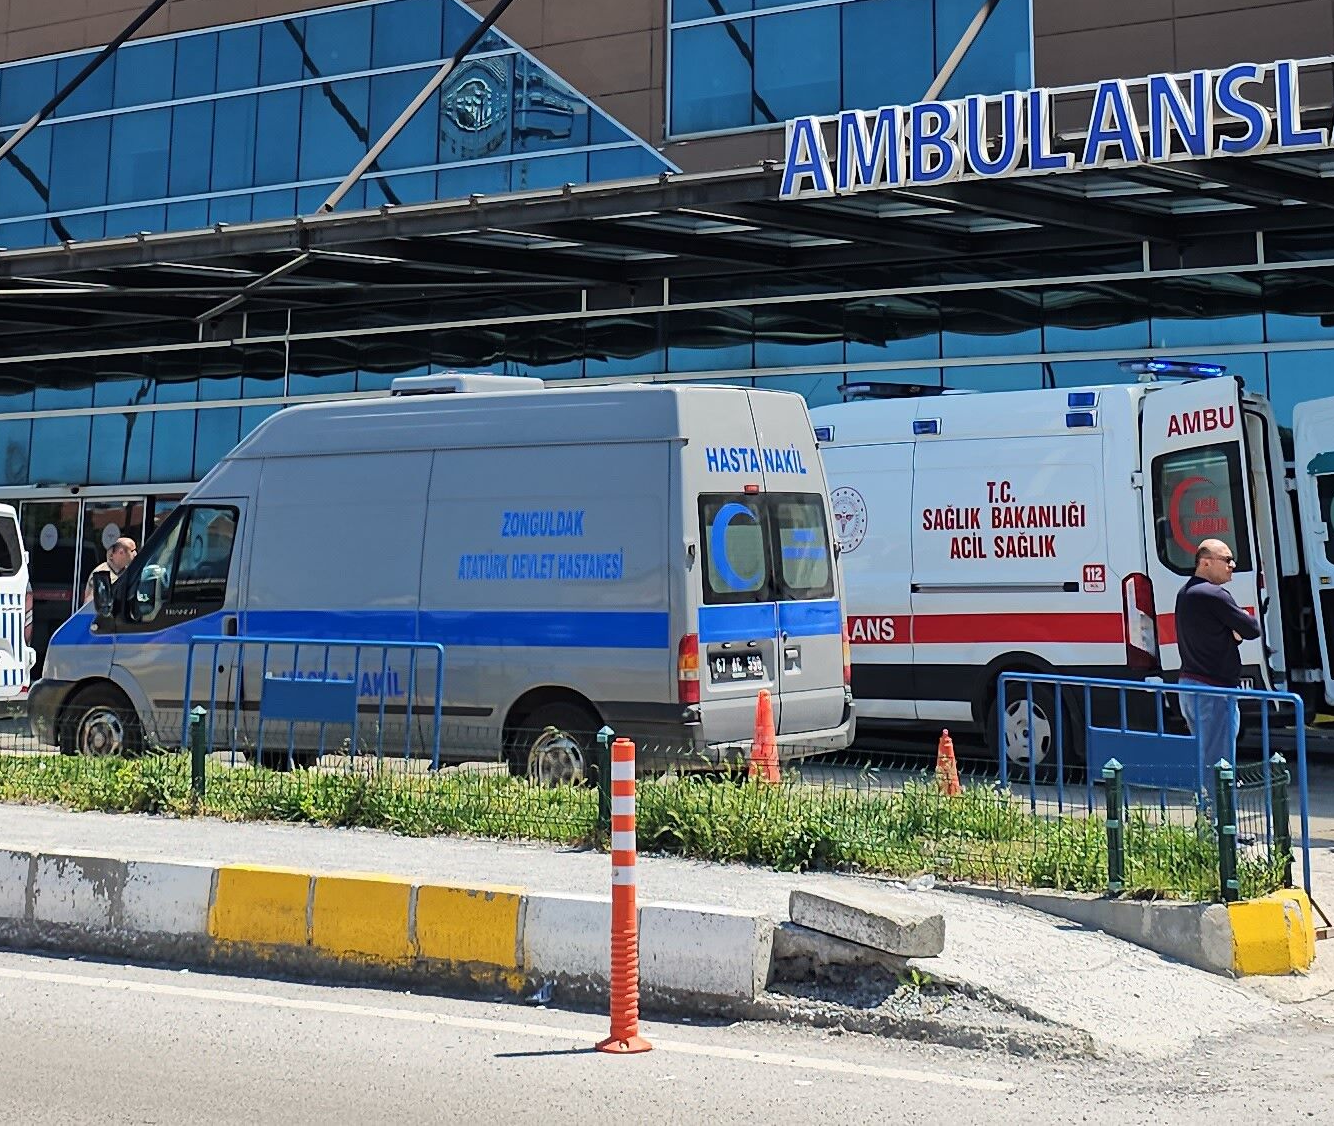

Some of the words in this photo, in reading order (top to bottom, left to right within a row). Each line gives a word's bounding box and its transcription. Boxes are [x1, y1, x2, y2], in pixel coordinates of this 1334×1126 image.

[1167, 405, 1234, 437] AMBU
[706, 447, 760, 472] HASTA
[763, 443, 807, 474] NAKİL
[987, 480, 1016, 504] T.C.
[501, 509, 586, 537] ZONGULDAK
[922, 504, 981, 531] SAĞLIK
[991, 500, 1086, 529] BAKANLIĞI
[950, 531, 987, 559] ACİL
[994, 531, 1056, 559] SAĞLIK
[458, 550, 508, 579] ATATÜRK
[511, 553, 555, 579] DEVLET
[558, 547, 625, 579] HASTANESİ
[1085, 567, 1103, 581] 112
[847, 617, 895, 641] ANS
[351, 666, 404, 697] AKİL
